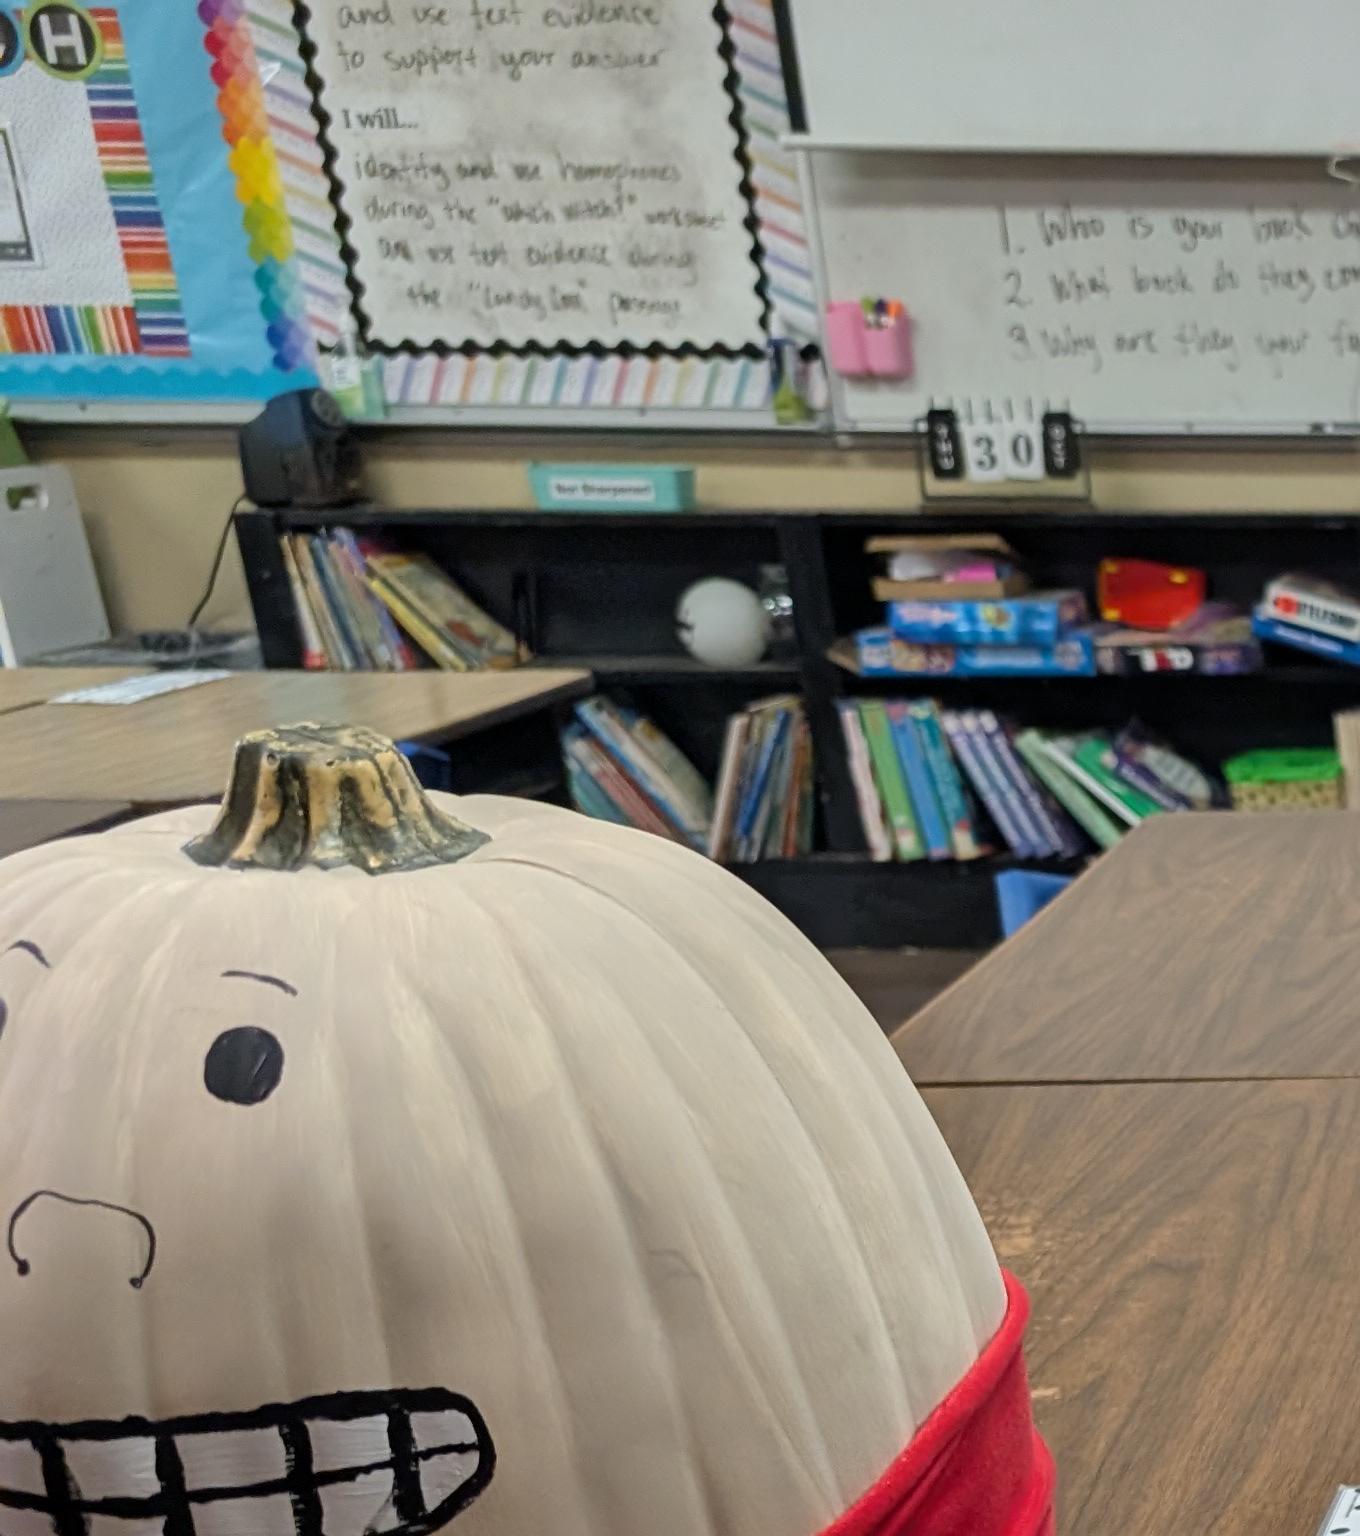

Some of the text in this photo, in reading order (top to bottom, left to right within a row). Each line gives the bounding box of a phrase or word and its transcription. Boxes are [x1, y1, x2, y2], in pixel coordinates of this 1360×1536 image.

[338, 2, 395, 29] and
[39, 13, 87, 65] H
[336, 41, 366, 71] to
[499, 50, 555, 82] your
[341, 108, 352, 130] I
[1038, 203, 1106, 247] Who
[1129, 214, 1155, 240] is
[1171, 214, 1224, 253] your
[973, 431, 1034, 472] 30
